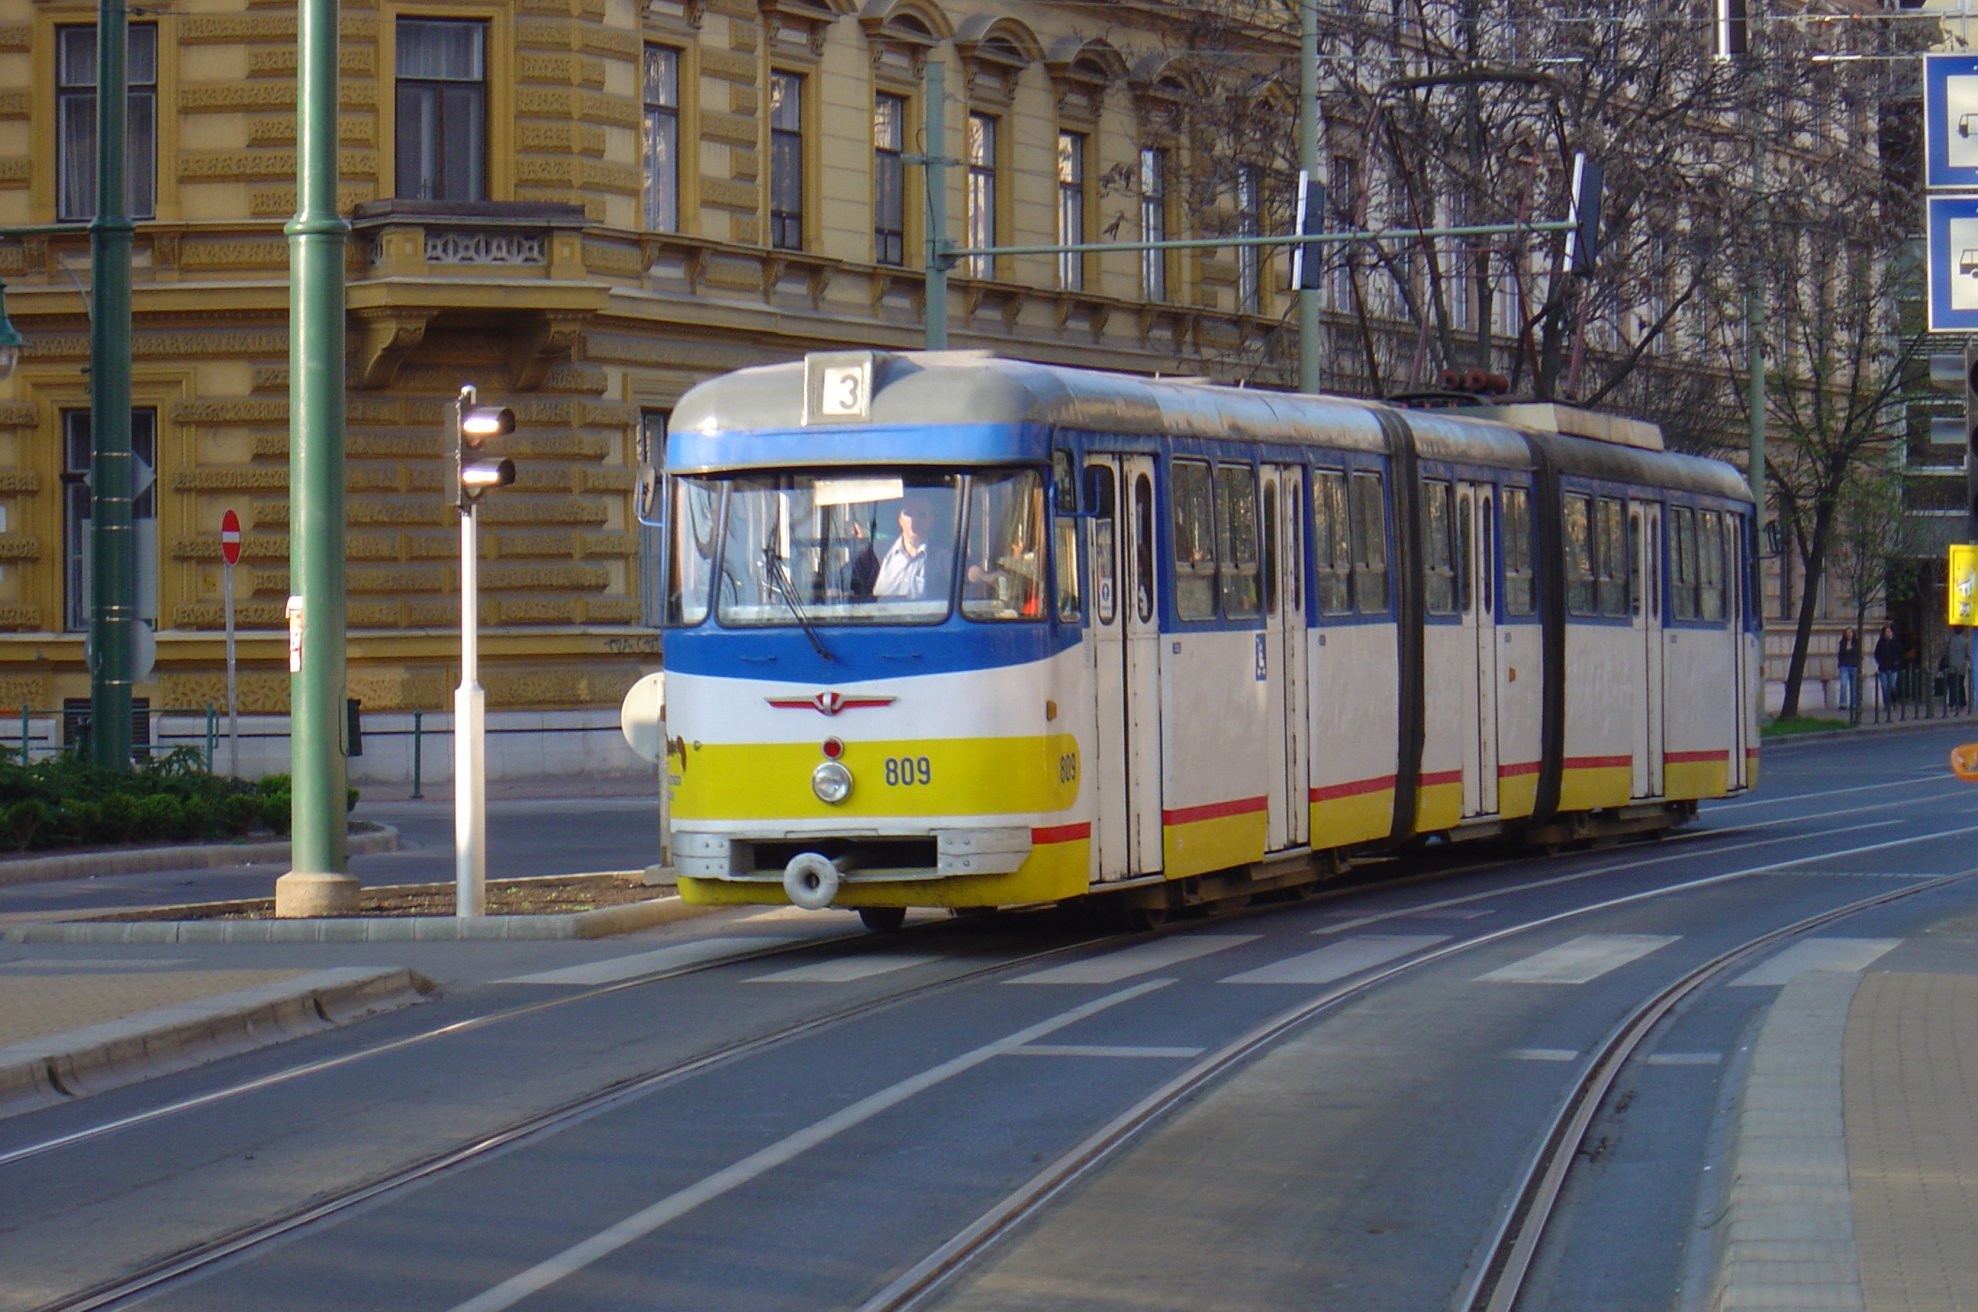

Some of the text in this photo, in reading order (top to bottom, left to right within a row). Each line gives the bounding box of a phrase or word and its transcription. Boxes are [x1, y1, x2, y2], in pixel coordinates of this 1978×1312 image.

[840, 374, 859, 410] 3
[885, 756, 931, 786] 809
[1060, 752, 1076, 784] 809
